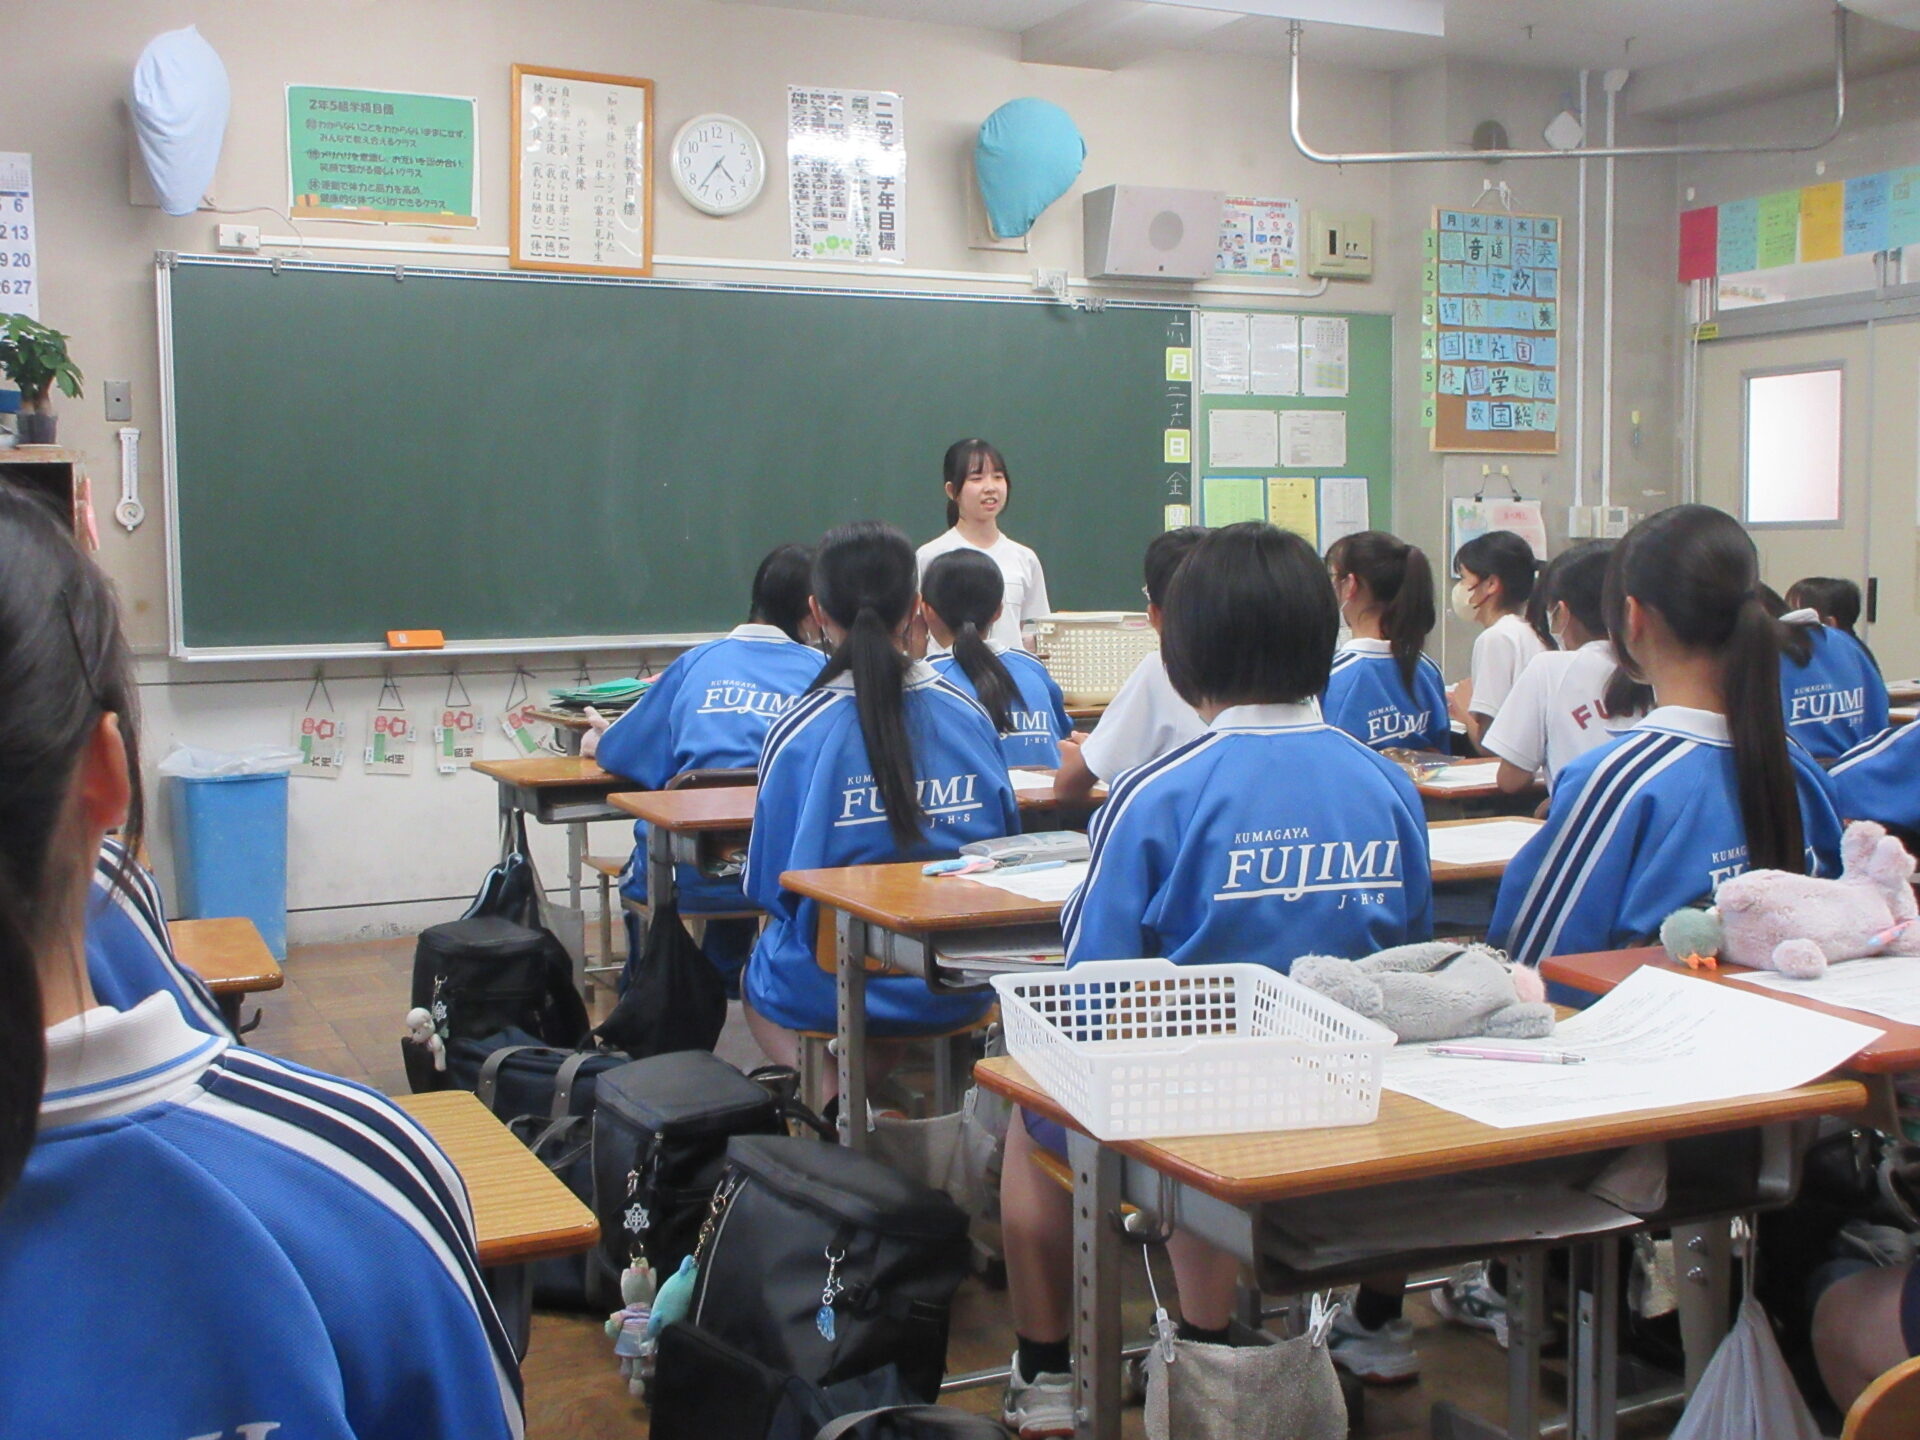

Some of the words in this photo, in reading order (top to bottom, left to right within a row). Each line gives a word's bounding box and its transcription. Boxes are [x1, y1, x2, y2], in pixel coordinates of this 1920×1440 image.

[699, 130, 708, 142] 11
[711, 126, 722, 139] 12
[688, 141, 699, 153] 10
[740, 143, 746, 155] 2
[683, 157, 691, 168] 9
[745, 159, 752, 172] 3
[623, 125, 637, 216] 学校教育目標
[689, 173, 697, 185] 8
[739, 174, 746, 187] 4
[702, 184, 709, 196] 7
[715, 188, 723, 201] 6
[730, 185, 737, 196] 5
[14, 198, 24, 213] 6
[1446, 214, 1457, 227] 月
[1470, 216, 1480, 228] 火
[1494, 218, 1504, 230] 水
[1517, 220, 1527, 232] 木
[11, 225, 29, 240] 13
[1427, 238, 1433, 248] 1
[1468, 238, 1484, 261] 音
[12, 252, 31, 268] 20
[1427, 271, 1433, 282] 2
[14, 280, 32, 295] 27
[1426, 304, 1433, 315] 3
[1425, 338, 1433, 349] 4
[1491, 340, 1509, 360] 社
[1426, 372, 1433, 382] 5
[1491, 369, 1509, 393] 学
[1425, 406, 1433, 417] 6
[1492, 403, 1512, 428] 国
[702, 687, 798, 714] FUJIM
[1791, 687, 1864, 724] FUJIMI
[1235, 827, 1310, 844] KUMAGAYA
[1711, 845, 1749, 864] KUMAG
[1222, 840, 1399, 902] FUJIMI
